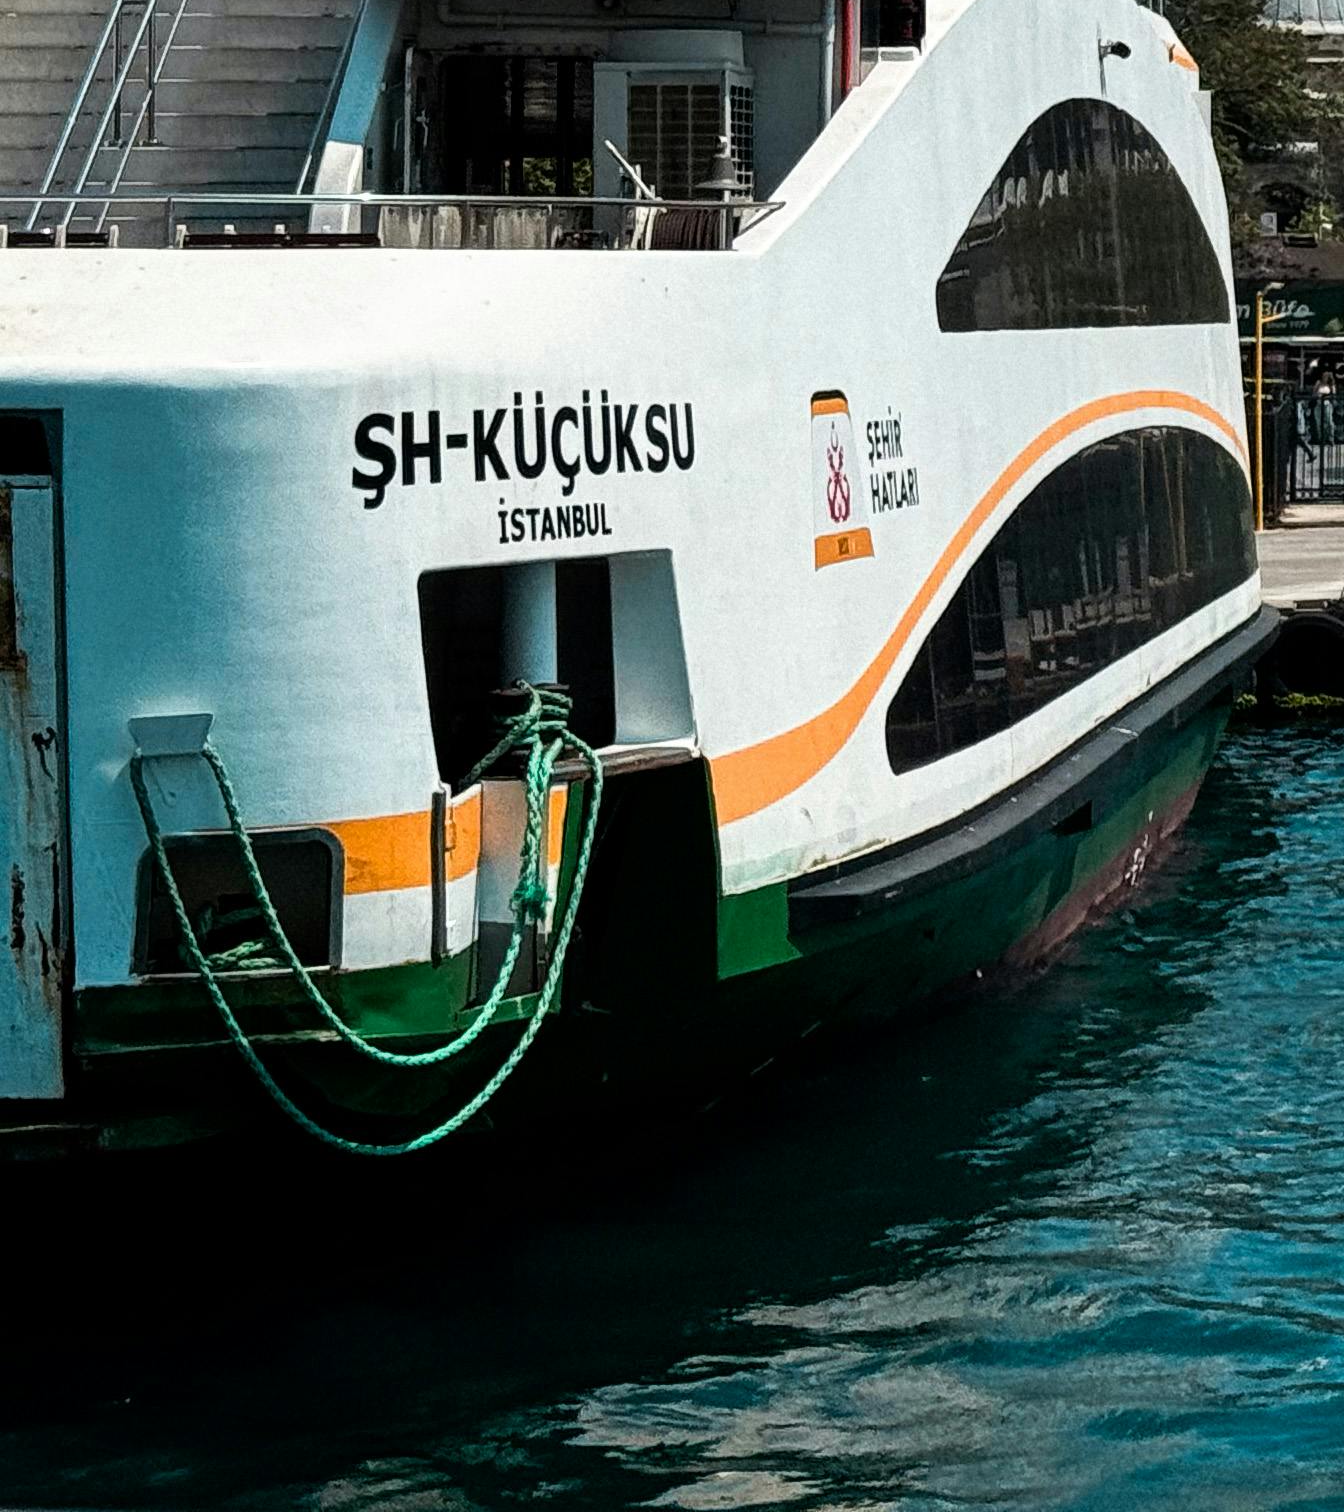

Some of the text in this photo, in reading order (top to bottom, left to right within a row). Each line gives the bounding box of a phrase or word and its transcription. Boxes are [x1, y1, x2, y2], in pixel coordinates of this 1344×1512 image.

[352, 389, 696, 510] ŞH-KÜÇÜKSU
[866, 405, 904, 468] ŞEHİR
[869, 466, 920, 515] HATLARI
[497, 497, 613, 544] İSTANBUL
